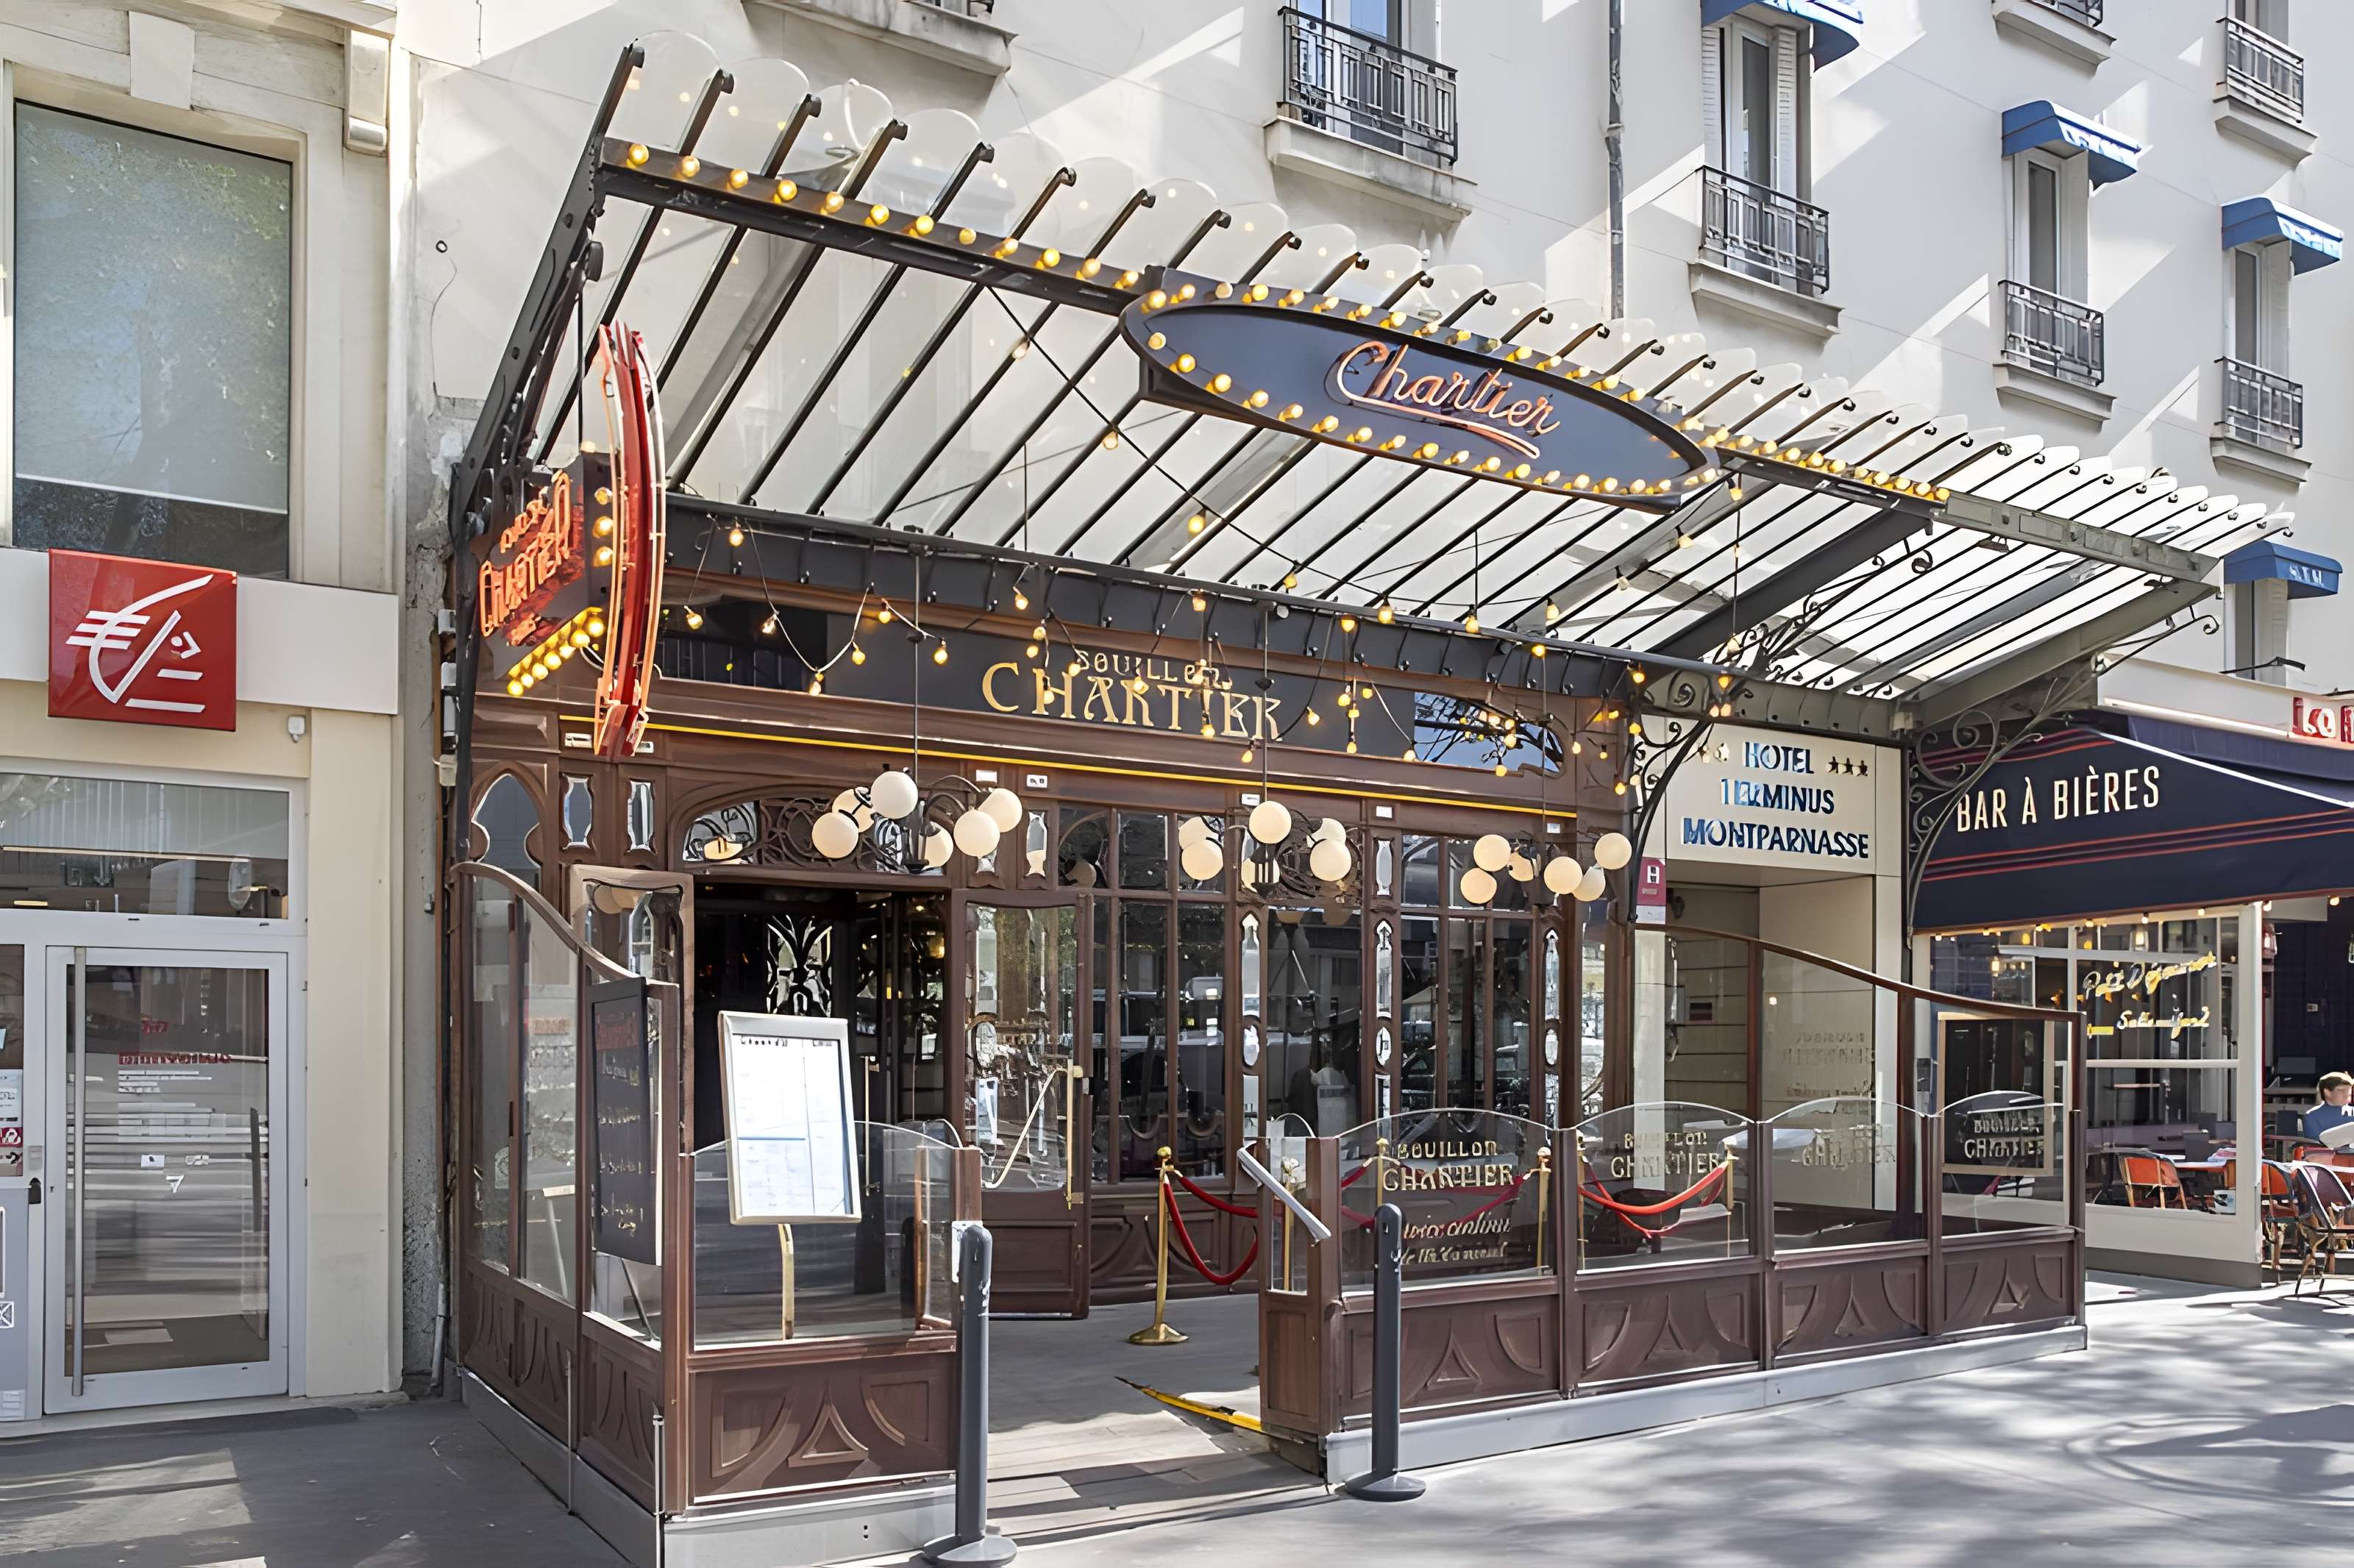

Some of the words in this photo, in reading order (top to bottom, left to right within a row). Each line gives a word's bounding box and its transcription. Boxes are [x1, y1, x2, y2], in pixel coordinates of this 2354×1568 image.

[1333, 340, 1560, 447] Chartier
[982, 661, 1281, 742] CHARTIER
[1742, 741, 1814, 774] HOTEL
[1721, 777, 1835, 814] TERMINUS
[1957, 788, 2008, 832] BAR
[2021, 776, 2037, 824] À
[2054, 765, 2160, 820] BIÈRES
[1682, 816, 1869, 859] MONTPARNASSE
[1398, 1141, 1498, 1160] BOUILLON
[1383, 1164, 1515, 1191] CHARTIER
